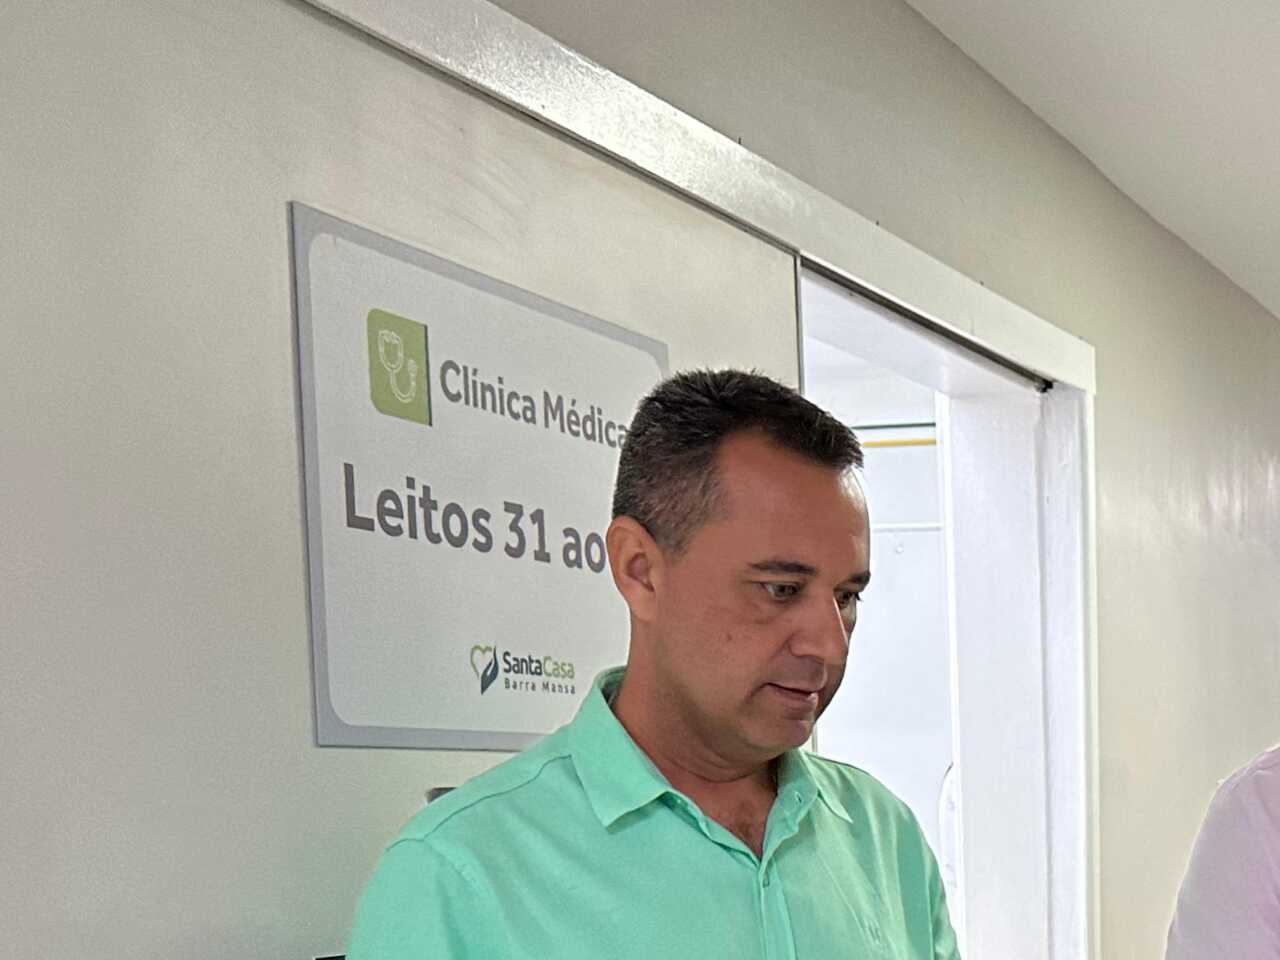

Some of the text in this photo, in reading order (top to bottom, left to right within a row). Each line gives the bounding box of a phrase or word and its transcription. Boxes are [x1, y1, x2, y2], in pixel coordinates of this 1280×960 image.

[439, 359, 537, 426] Clínica
[343, 462, 607, 574] Leitos 31 ao
[504, 678, 576, 695] Barra Mansa
